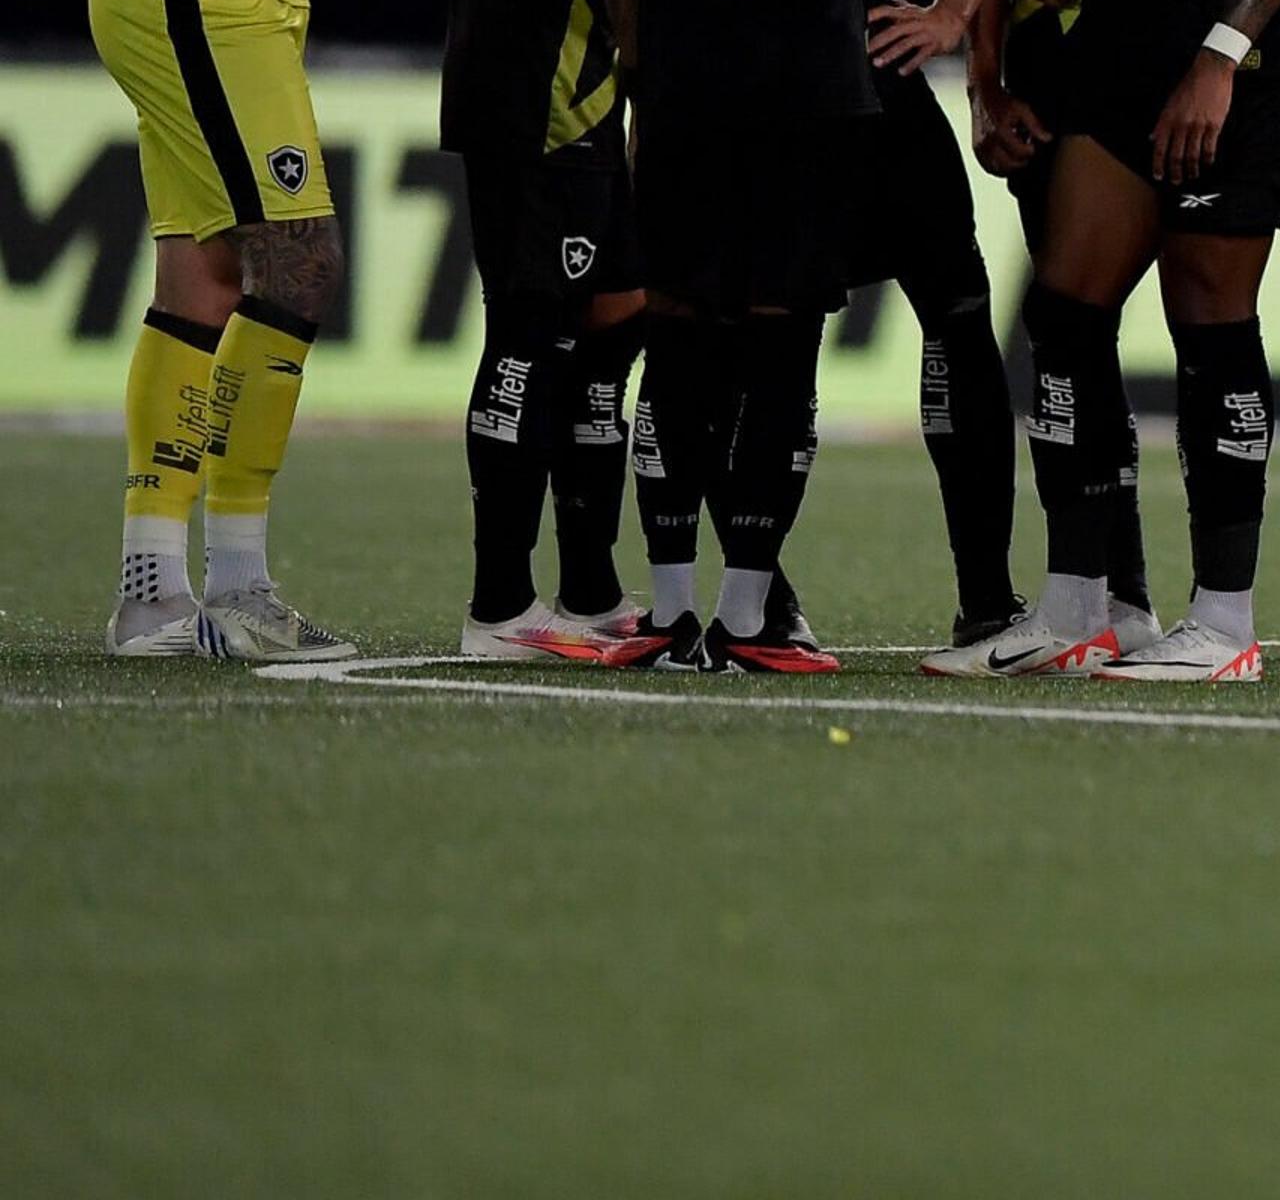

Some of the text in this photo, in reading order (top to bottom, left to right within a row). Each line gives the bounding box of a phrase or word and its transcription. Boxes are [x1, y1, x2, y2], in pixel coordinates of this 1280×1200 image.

[483, 357, 533, 427] Lifefit
[1039, 371, 1076, 432] Lifefit
[1221, 391, 1268, 454] Lifefit
